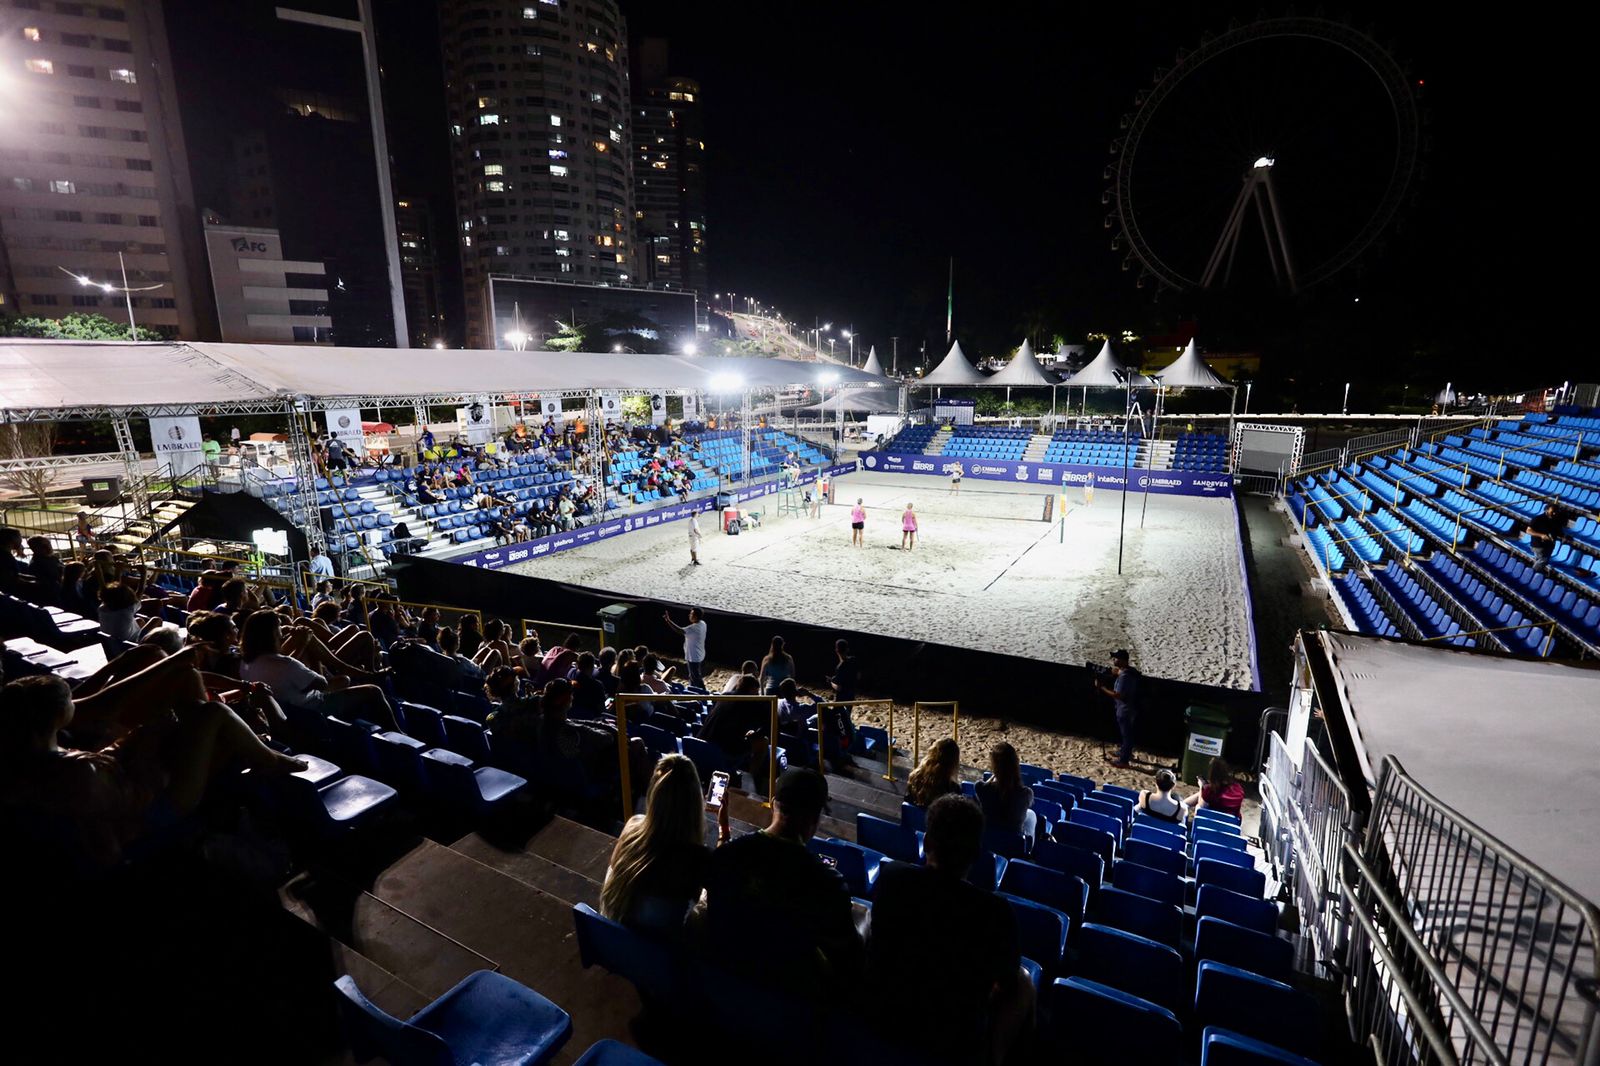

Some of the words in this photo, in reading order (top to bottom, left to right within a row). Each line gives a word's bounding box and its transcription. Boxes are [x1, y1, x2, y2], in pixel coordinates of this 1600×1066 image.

[238, 238, 267, 252] AFG
[157, 442, 201, 451] EMBRAED
[1071, 474, 1088, 483] BRB
[1151, 478, 1182, 486] EMBRAED
[1192, 480, 1228, 488] SANDEVER
